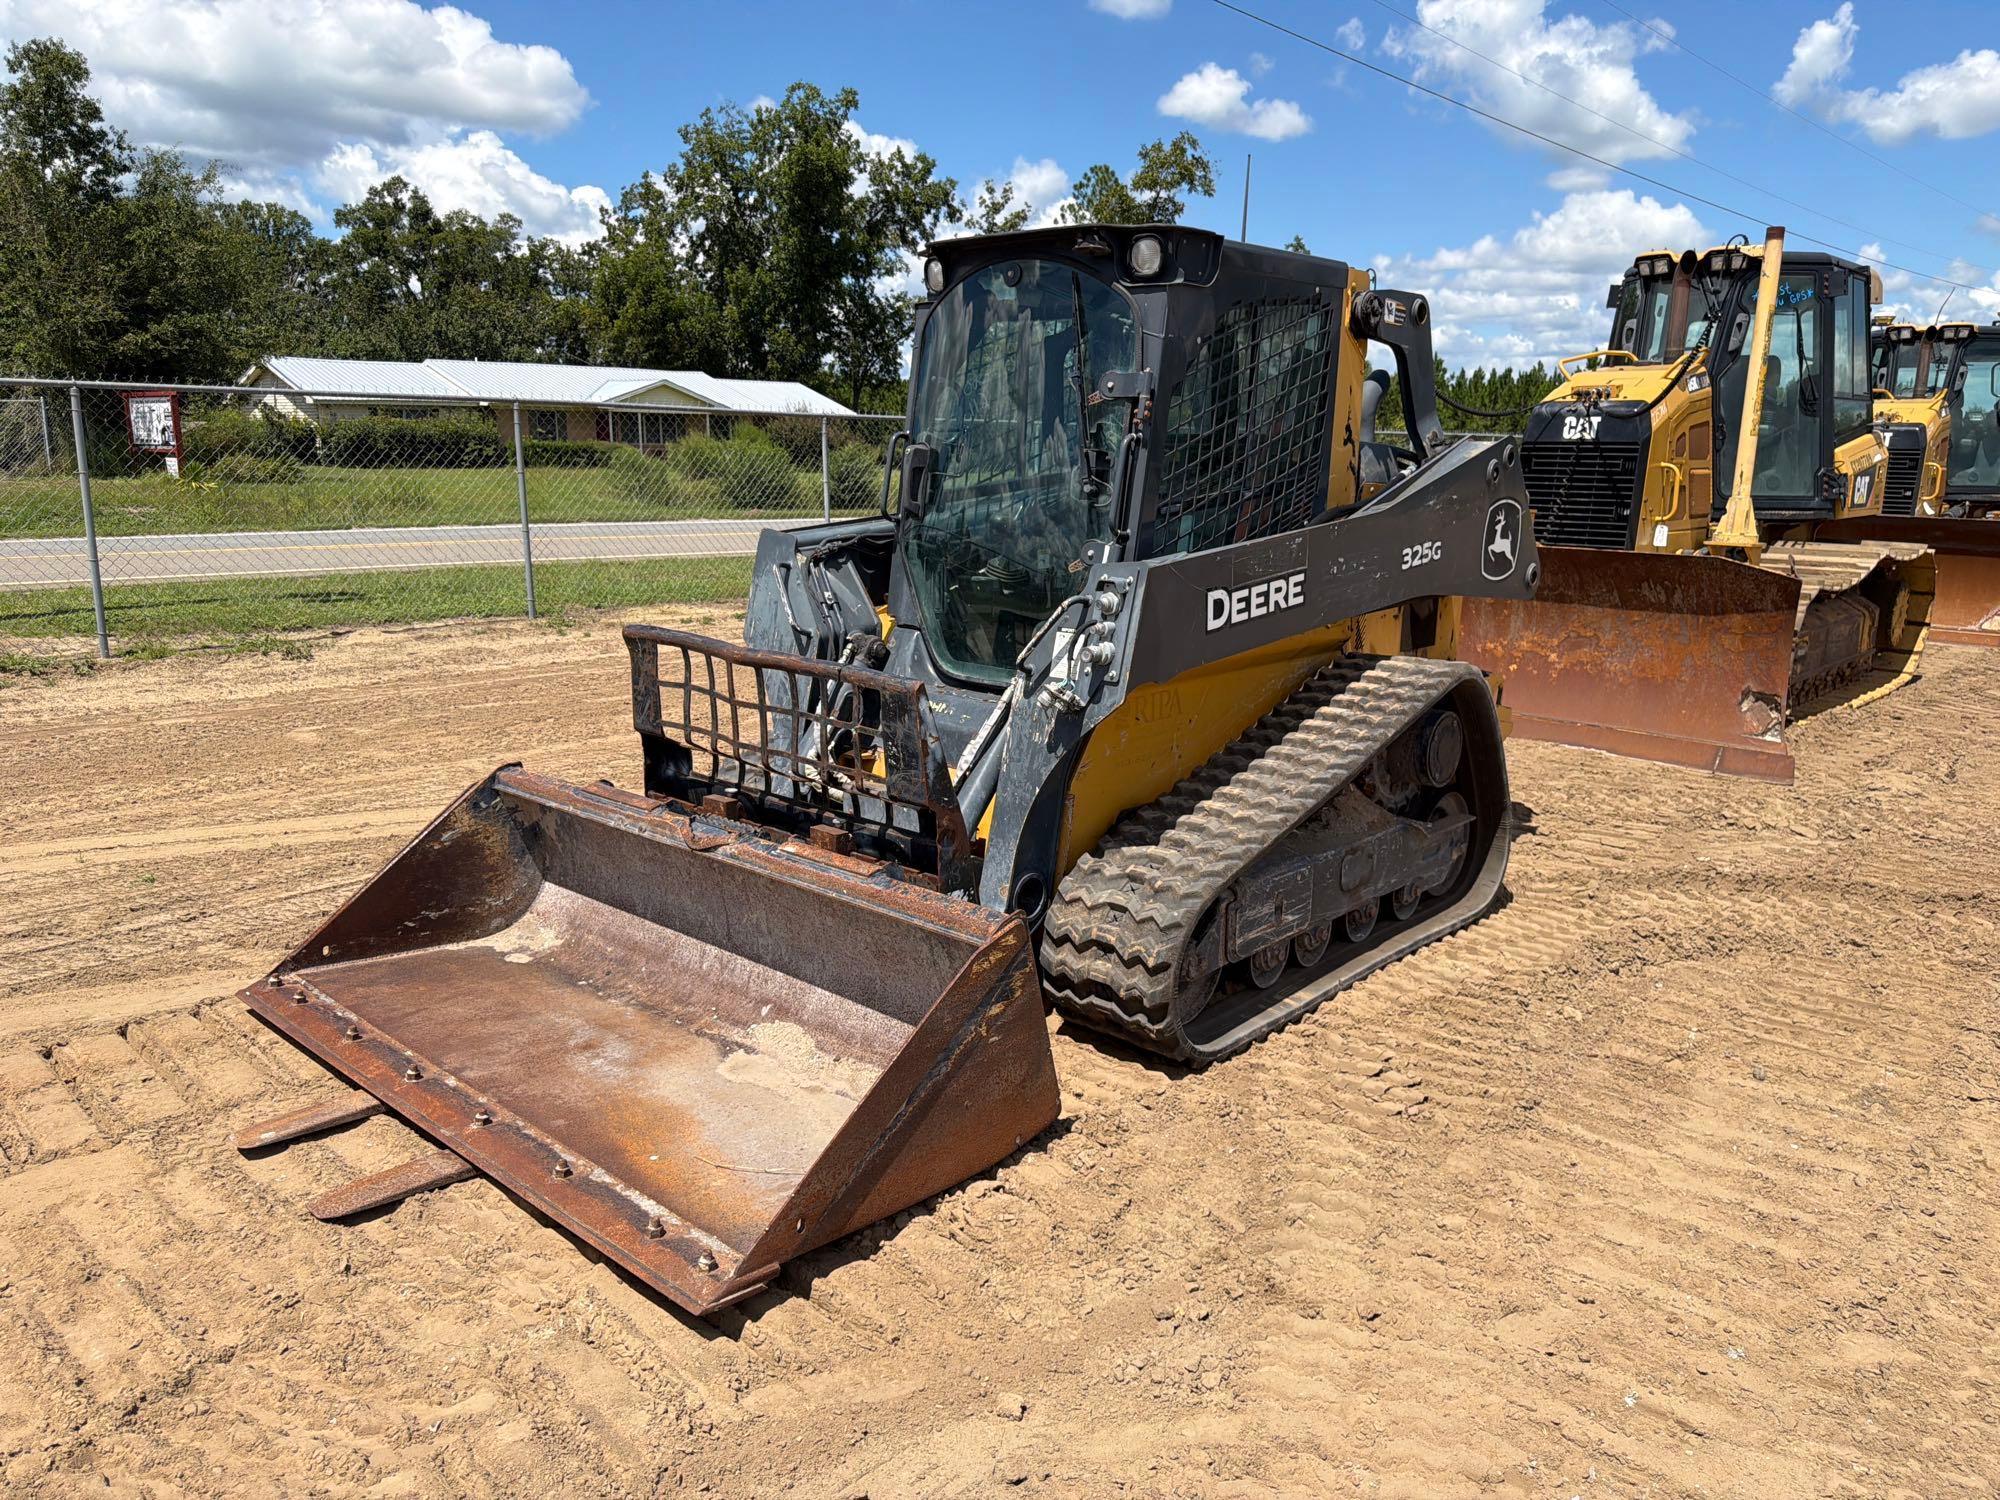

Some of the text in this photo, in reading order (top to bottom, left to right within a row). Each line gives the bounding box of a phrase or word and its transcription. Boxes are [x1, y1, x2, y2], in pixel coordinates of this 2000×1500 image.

[1563, 416, 1602, 440] CAT
[1854, 475, 1870, 504] CAT
[1401, 541, 1442, 570] 325G
[1207, 573, 1305, 631] DEERE
